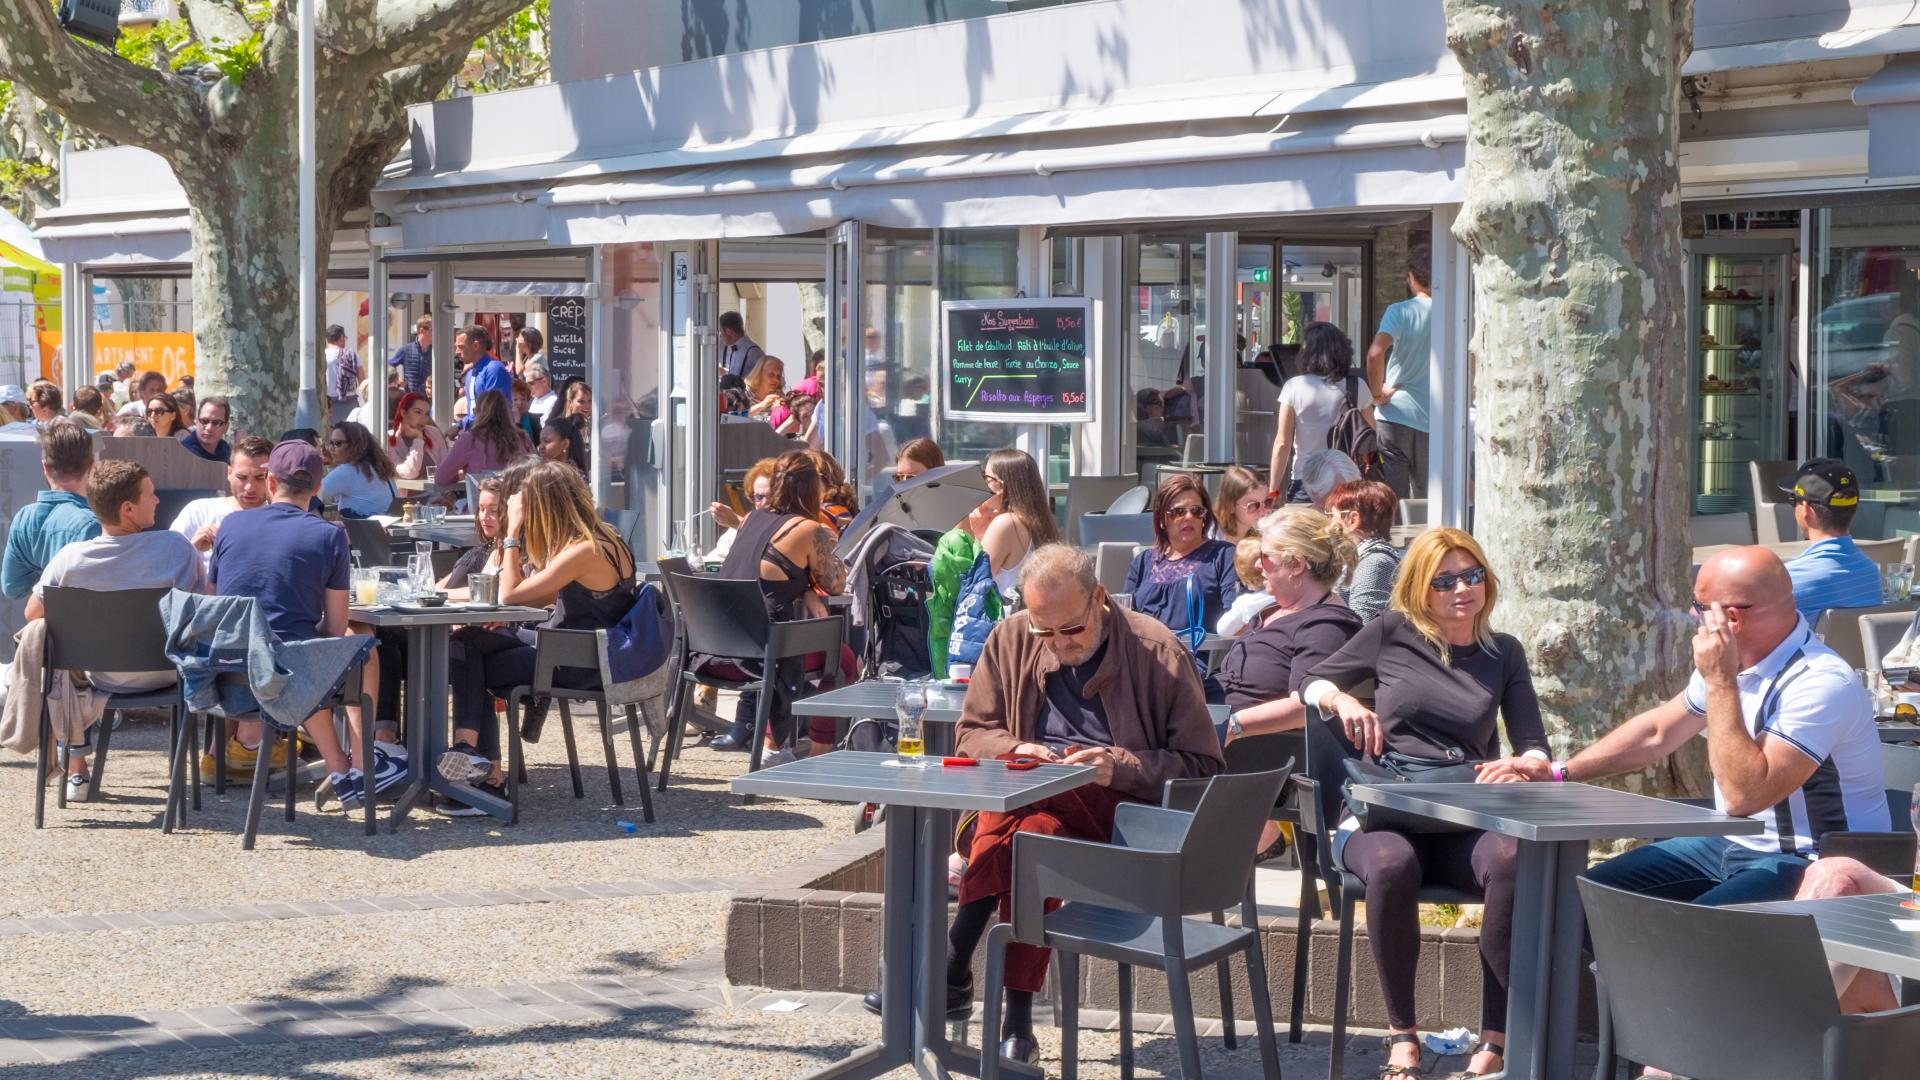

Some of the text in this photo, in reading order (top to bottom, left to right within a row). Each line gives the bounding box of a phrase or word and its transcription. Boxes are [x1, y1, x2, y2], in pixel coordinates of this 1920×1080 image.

[551, 298, 586, 326] CRÊP
[957, 339, 973, 352] Filet
[975, 340, 984, 351] de
[95, 346, 188, 387] ARTEMENT 06
[974, 359, 983, 369] de
[954, 374, 972, 387] Curry
[1008, 393, 1020, 401] aux
[1024, 390, 1054, 408] Asperges
